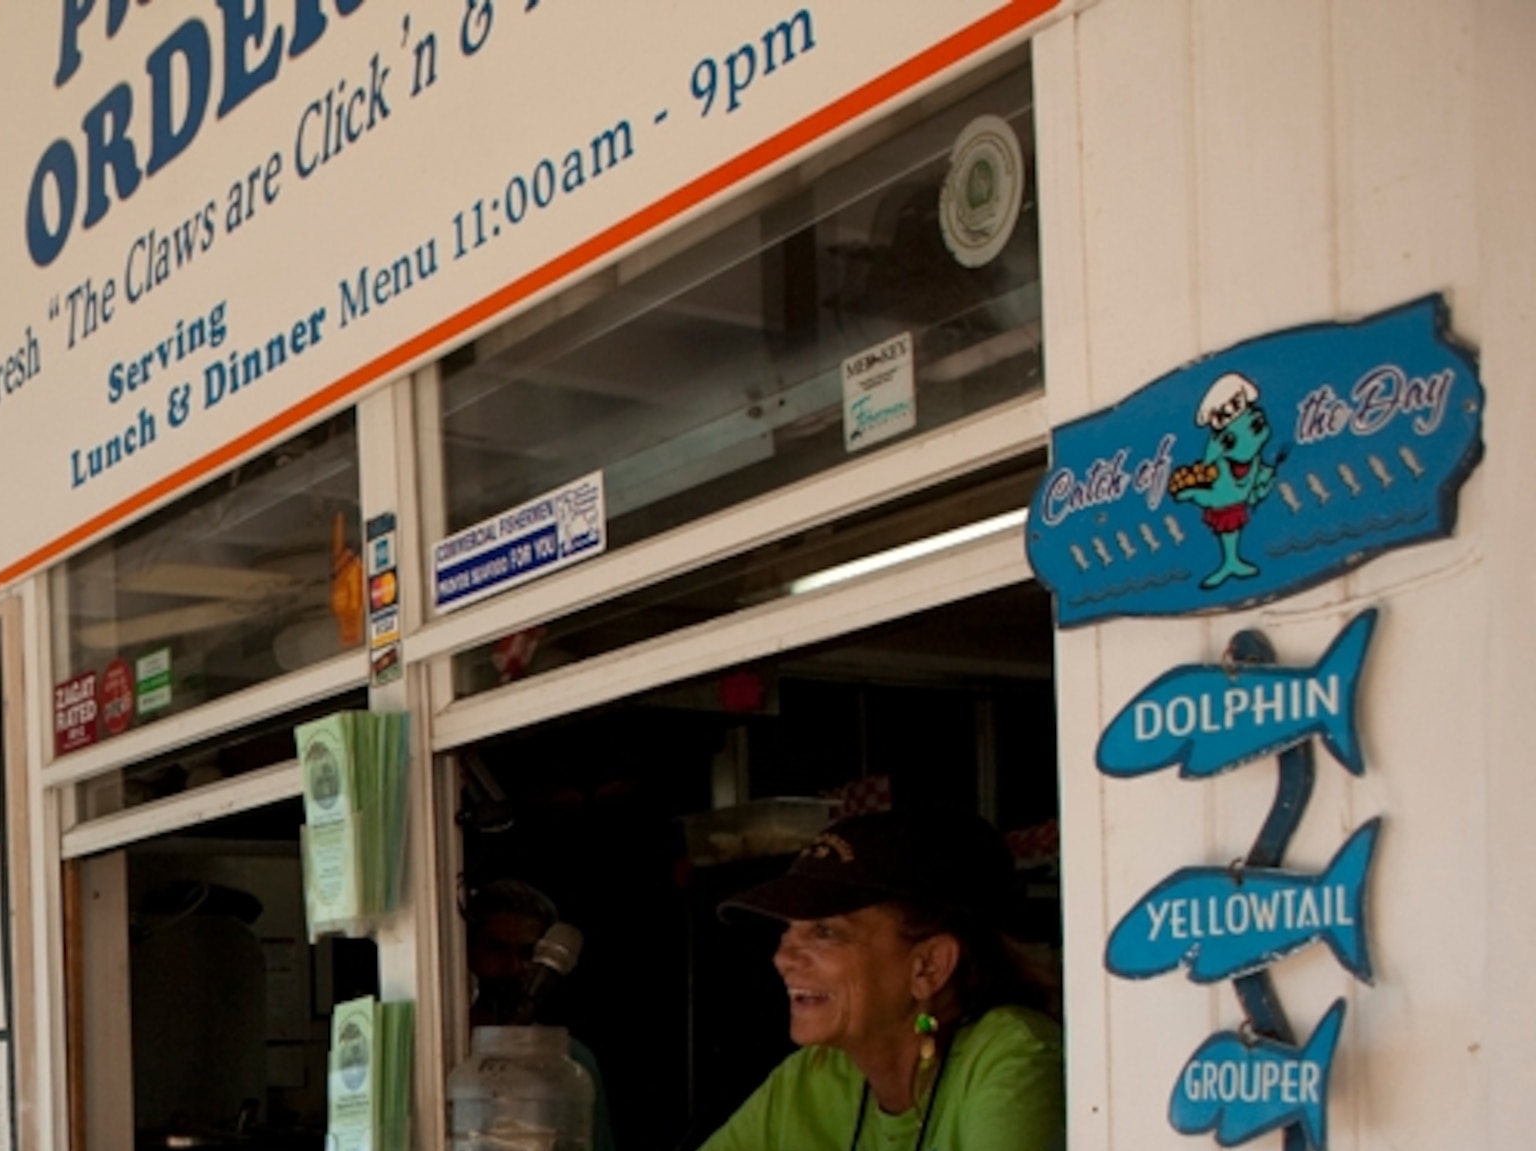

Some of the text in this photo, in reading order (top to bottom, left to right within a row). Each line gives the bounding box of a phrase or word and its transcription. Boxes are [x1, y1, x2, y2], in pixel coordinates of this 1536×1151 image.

[70, 406, 157, 489] Lunch
[167, 383, 193, 429] &
[202, 306, 327, 410] Dinner
[337, 238, 438, 330] Menu
[452, 117, 636, 261] 11:00am
[689, 7, 817, 118] 9pm
[124, 200, 216, 304] Claws
[224, 149, 282, 235] are
[108, 300, 227, 404] Serving
[1041, 364, 1456, 526] Catch of the Day
[511, 543, 533, 572] FOR
[535, 533, 558, 561] YOU
[1134, 674, 1340, 741] DOLPHIN
[1146, 884, 1355, 941] YELLOWTAIL
[1184, 1059, 1322, 1104] GROUPER
